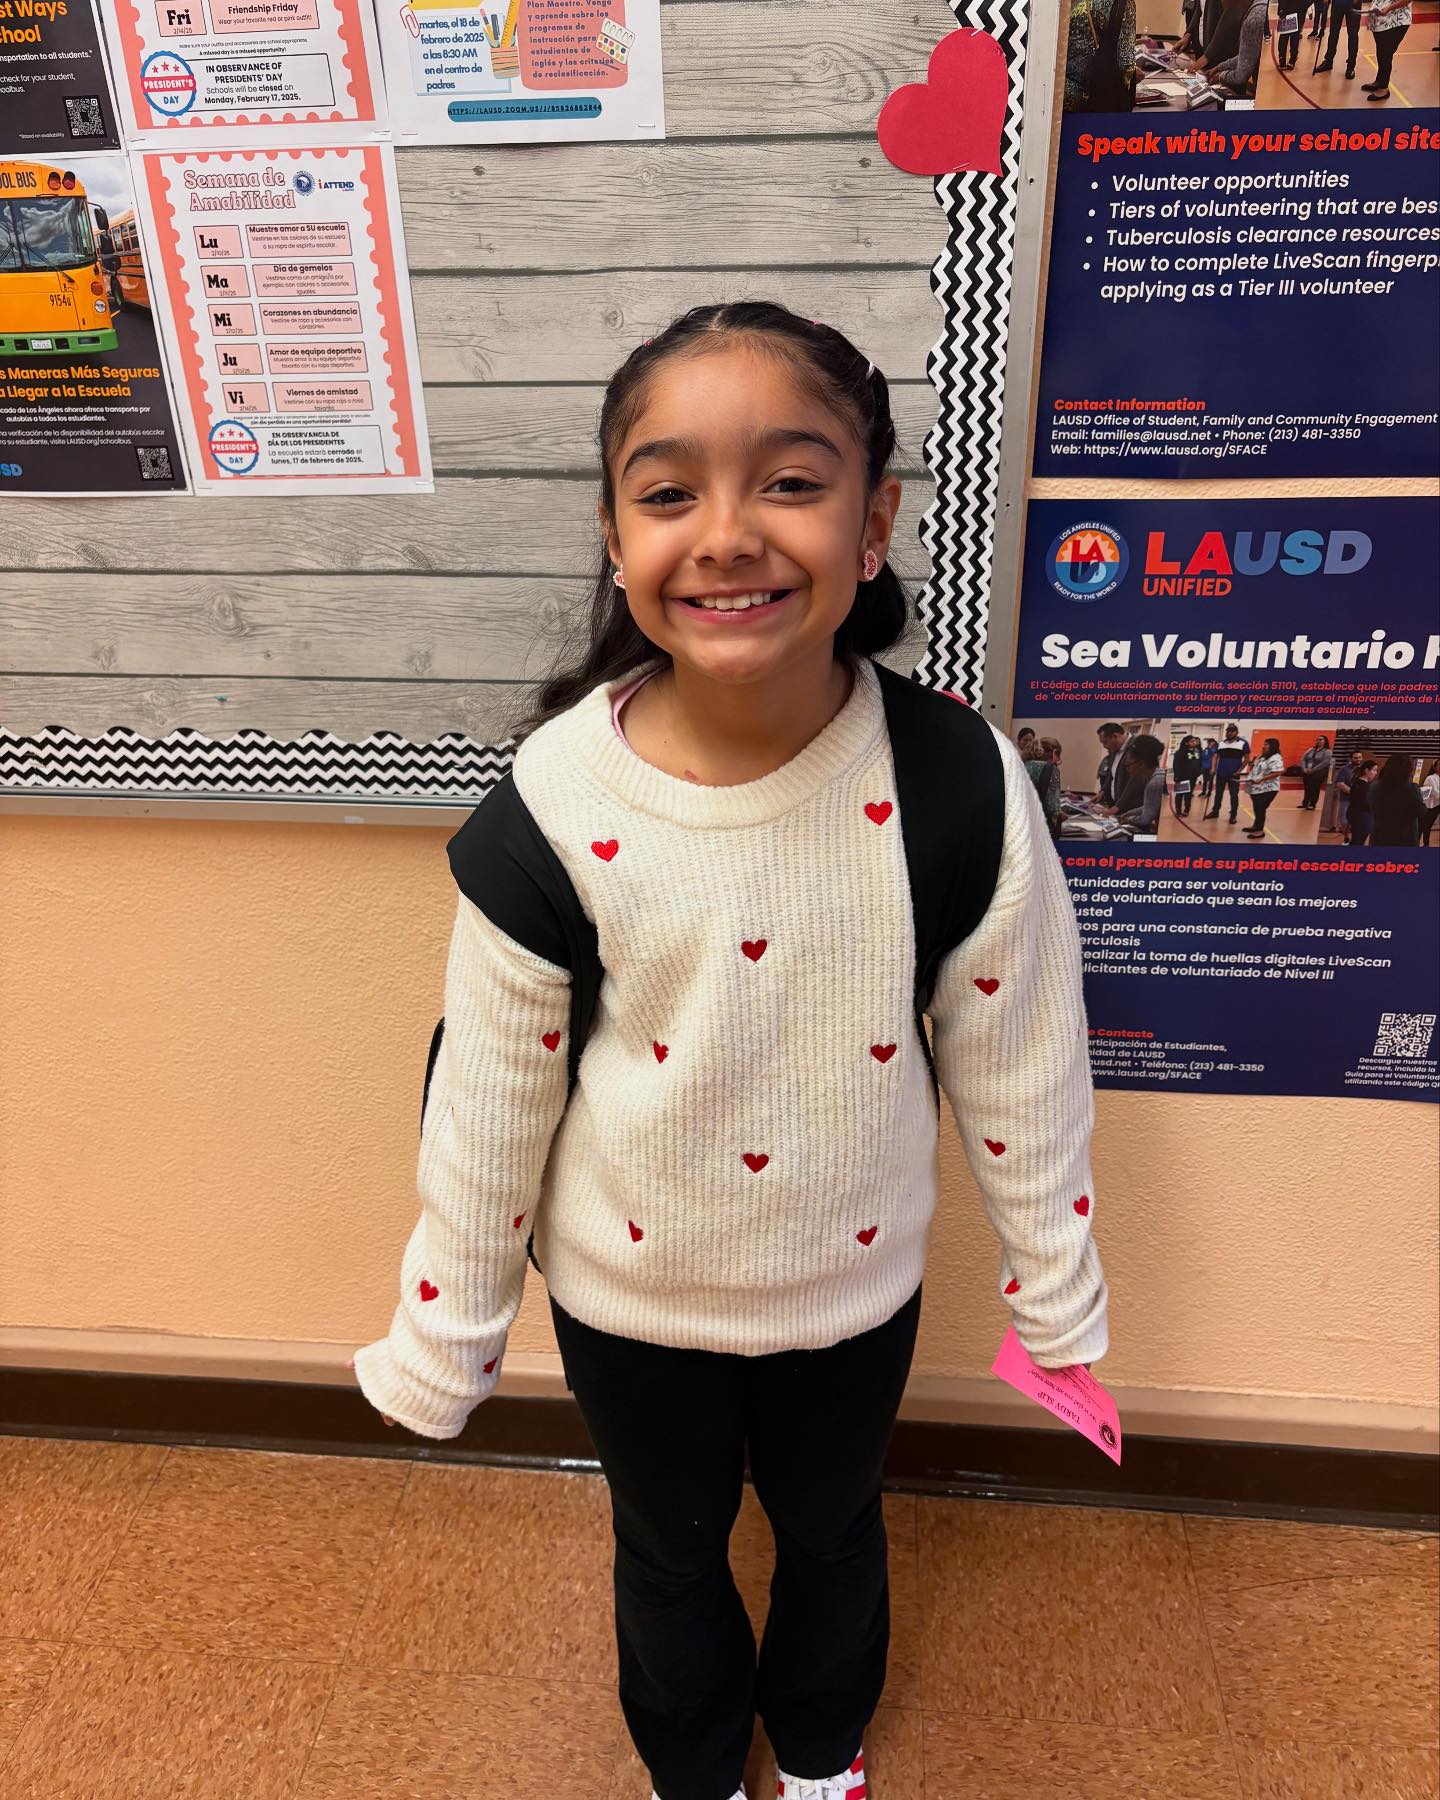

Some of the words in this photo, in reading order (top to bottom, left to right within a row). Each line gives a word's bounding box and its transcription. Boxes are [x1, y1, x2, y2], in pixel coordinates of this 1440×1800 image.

[15, 0, 68, 22] Ways
[228, 4, 271, 14] Friendship
[272, 3, 298, 14] Friday
[166, 9, 192, 26] Fri
[418, 20, 450, 30] martes,
[450, 18, 459, 28] el
[459, 18, 468, 28] 18
[468, 17, 480, 27] de
[529, 25, 572, 34] programas
[575, 22, 585, 30] de
[420, 34, 451, 44] febrero
[452, 33, 464, 43] de
[464, 32, 485, 43] 2025
[429, 49, 442, 59] las
[442, 48, 461, 59] 8:30
[462, 48, 478, 58] AM
[206, 65, 215, 73] IN
[216, 62, 270, 72] OBSERVANCE
[271, 62, 282, 70] OF
[436, 65, 444, 74] el
[444, 65, 470, 74] centro
[471, 64, 483, 73] de
[144, 79, 194, 89] PRESIDENT'S
[214, 74, 264, 84] PRESIDENTS'
[266, 73, 282, 82] DAY
[206, 86, 234, 94] Schools
[234, 85, 247, 93] will
[247, 85, 258, 93] be
[258, 84, 283, 92] closed
[426, 80, 456, 92] padres
[163, 96, 179, 104] DAY
[204, 96, 236, 105] Monday,
[237, 95, 270, 104] February
[271, 94, 280, 102] 17,
[280, 93, 301, 101] 2025.
[1078, 132, 1162, 163] Speak
[1166, 129, 1226, 154] with
[1231, 134, 1296, 160] your
[1299, 128, 1391, 151] school
[15, 171, 37, 188] BUS
[183, 169, 261, 190] Semana
[262, 166, 286, 187] de
[318, 179, 322, 189] i
[323, 182, 354, 190] ATTEND
[1112, 174, 1210, 192] Volunteer
[1214, 170, 1350, 194] opportunities
[189, 188, 296, 212] Amabilidad
[1110, 200, 1156, 219] Tiers
[1160, 200, 1181, 218] of
[1185, 198, 1312, 220] volunteering
[1317, 198, 1359, 215] that
[1363, 201, 1397, 214] are
[199, 234, 218, 248] Lu
[1107, 226, 1232, 246] Tuberculosis
[1236, 226, 1337, 243] clearance
[1342, 227, 1440, 241] resources
[273, 264, 287, 272] Día
[299, 265, 333, 274] gemelos
[1104, 256, 1146, 272] How
[1150, 256, 1170, 271] to
[1174, 253, 1269, 275] complete
[1274, 252, 1361, 269] LiveScan
[206, 274, 229, 288] Ma
[1100, 280, 1187, 303] applying
[1192, 284, 1215, 296] as
[1220, 283, 1233, 296] a
[1238, 279, 1274, 296] Tier
[1278, 279, 1295, 295] III
[1300, 278, 1395, 295] volunteer
[312, 307, 358, 316] abundancia
[213, 313, 232, 327] Mi
[222, 353, 238, 366] Ju
[7, 367, 69, 380] Maneras
[70, 365, 100, 378] Más
[102, 366, 160, 382] Seguras
[6, 385, 49, 401] Llegar
[51, 387, 61, 397] a
[62, 384, 77, 397] la
[77, 384, 132, 397] Escuela
[227, 391, 244, 404] Vi
[1054, 399, 1113, 410] Contact
[1116, 397, 1206, 411] Information
[1052, 429, 1088, 440] Email:
[1091, 429, 1212, 442] families@lausd.net
[1222, 429, 1266, 440] Phone:
[1268, 428, 1298, 442] (213)
[1301, 428, 1361, 439] 481-3350
[1050, 444, 1081, 454] Web:
[1084, 442, 1268, 457] https://www.lausd.org/SFACE
[1060, 530, 1071, 540] LOS
[1072, 523, 1099, 532] ANGELES
[1100, 524, 1120, 541] UNIFIED
[1144, 530, 1373, 576] LAUSD
[1054, 582, 1071, 596] READY
[1096, 582, 1116, 598] WORLD
[1143, 578, 1232, 596] UNIFIED
[1041, 634, 1131, 668] Sea
[1141, 629, 1415, 669] Voluntario
[1175, 704, 1226, 712] escolares
[1228, 706, 1235, 715] y
[1237, 704, 1252, 713] los
[1254, 706, 1315, 716] programas
[1317, 705, 1376, 714] escolares".
[1066, 858, 1096, 867] con
[1099, 856, 1114, 867] el
[1116, 857, 1190, 870] personal
[1192, 857, 1213, 869] de
[1215, 860, 1236, 869] su
[1238, 858, 1298, 872] plantel
[1300, 860, 1364, 872] escolar
[1365, 861, 1420, 874] sobre:
[1148, 880, 1183, 892] para
[1186, 881, 1208, 890] ser
[1211, 880, 1284, 891] voluntario
[1102, 923, 1135, 934] para
[1139, 924, 1166, 932] una
[1169, 924, 1248, 934] constancia
[1251, 925, 1270, 935] de
[1272, 926, 1324, 938] prueba
[1327, 928, 1392, 941] negativa
[1150, 965, 1168, 975] de
[1171, 966, 1261, 978] voluntariado
[1263, 968, 1282, 978] de
[1284, 968, 1320, 979] Nivel
[1322, 970, 1334, 980] III
[1133, 1050, 1166, 1059] LAUSD
[1359, 1057, 1402, 1065] Descargue
[1141, 1060, 1187, 1071] Teléfono:
[1189, 1060, 1214, 1072] (213)
[1216, 1063, 1264, 1072] 481-3350
[1038, 1392, 1055, 1405] SLIP
[1056, 1402, 1080, 1424] TARDY
